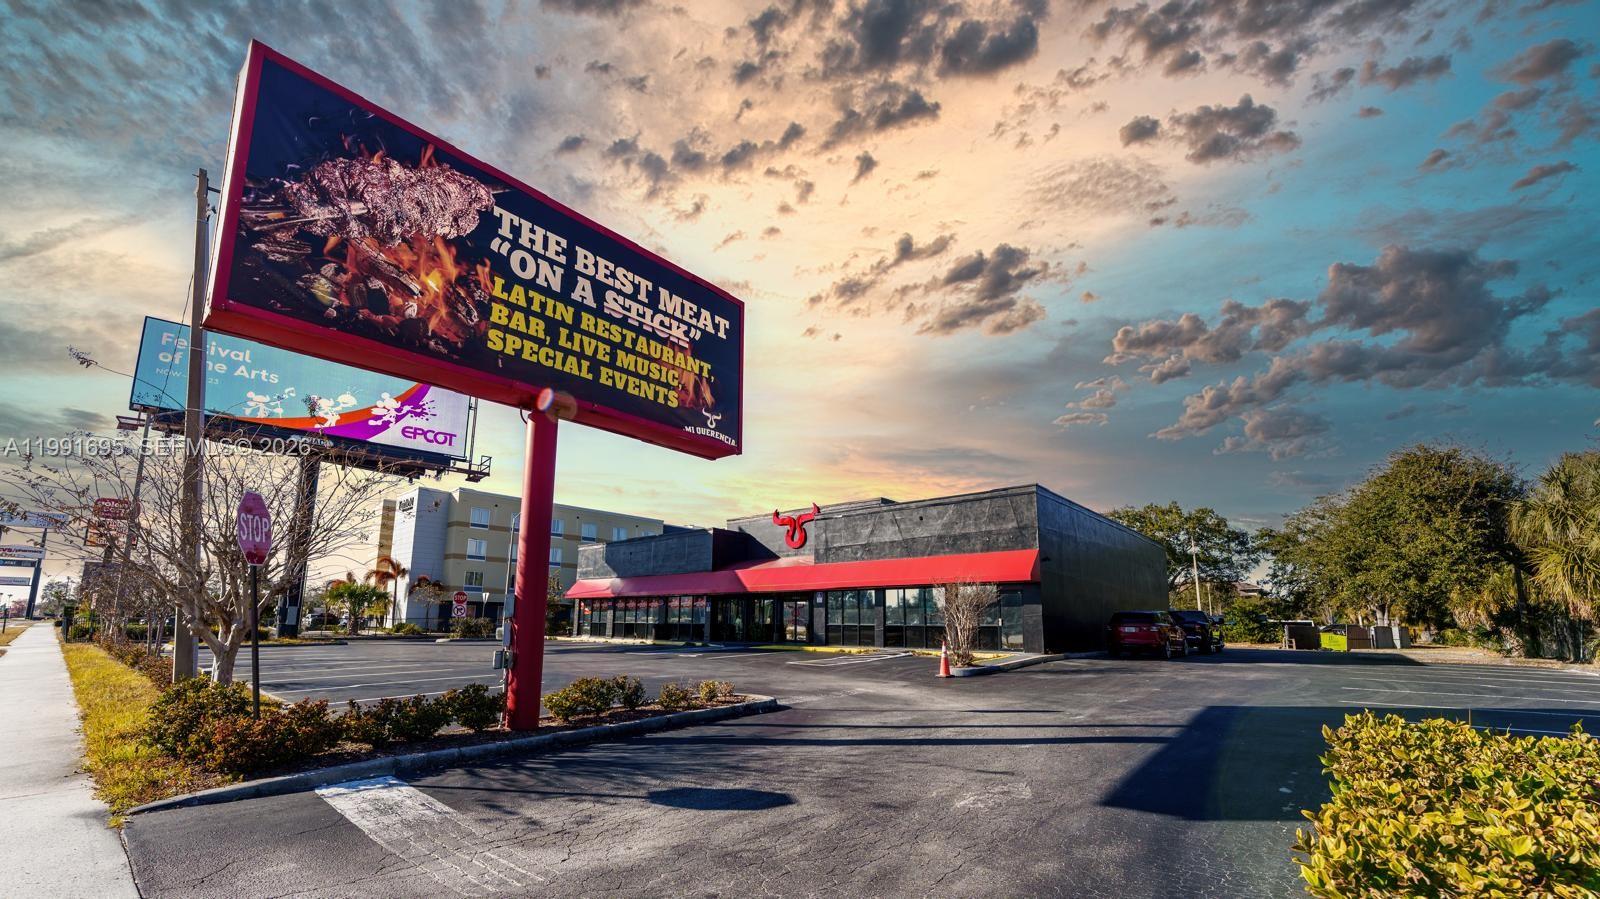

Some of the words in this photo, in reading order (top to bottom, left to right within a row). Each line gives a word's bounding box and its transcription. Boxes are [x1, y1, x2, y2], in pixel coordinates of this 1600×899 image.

[490, 236, 564, 293] “ON
[571, 276, 596, 308] A
[603, 290, 701, 348] STICK”
[493, 205, 567, 265] THE
[574, 246, 652, 303] BEST
[658, 286, 730, 340] MEAT
[158, 351, 184, 365] of
[233, 365, 279, 384] Arts
[161, 332, 252, 363] Feival
[487, 329, 593, 381] SPECIAL
[599, 368, 679, 408] EVENTS
[490, 303, 551, 345] BAR,
[558, 327, 610, 363] LIVE
[616, 349, 683, 392] MUSIC,
[492, 276, 574, 325] LATIN
[581, 310, 714, 383] RESTAURANT,
[401, 426, 457, 446] EPCOT
[240, 512, 269, 543] STOP
